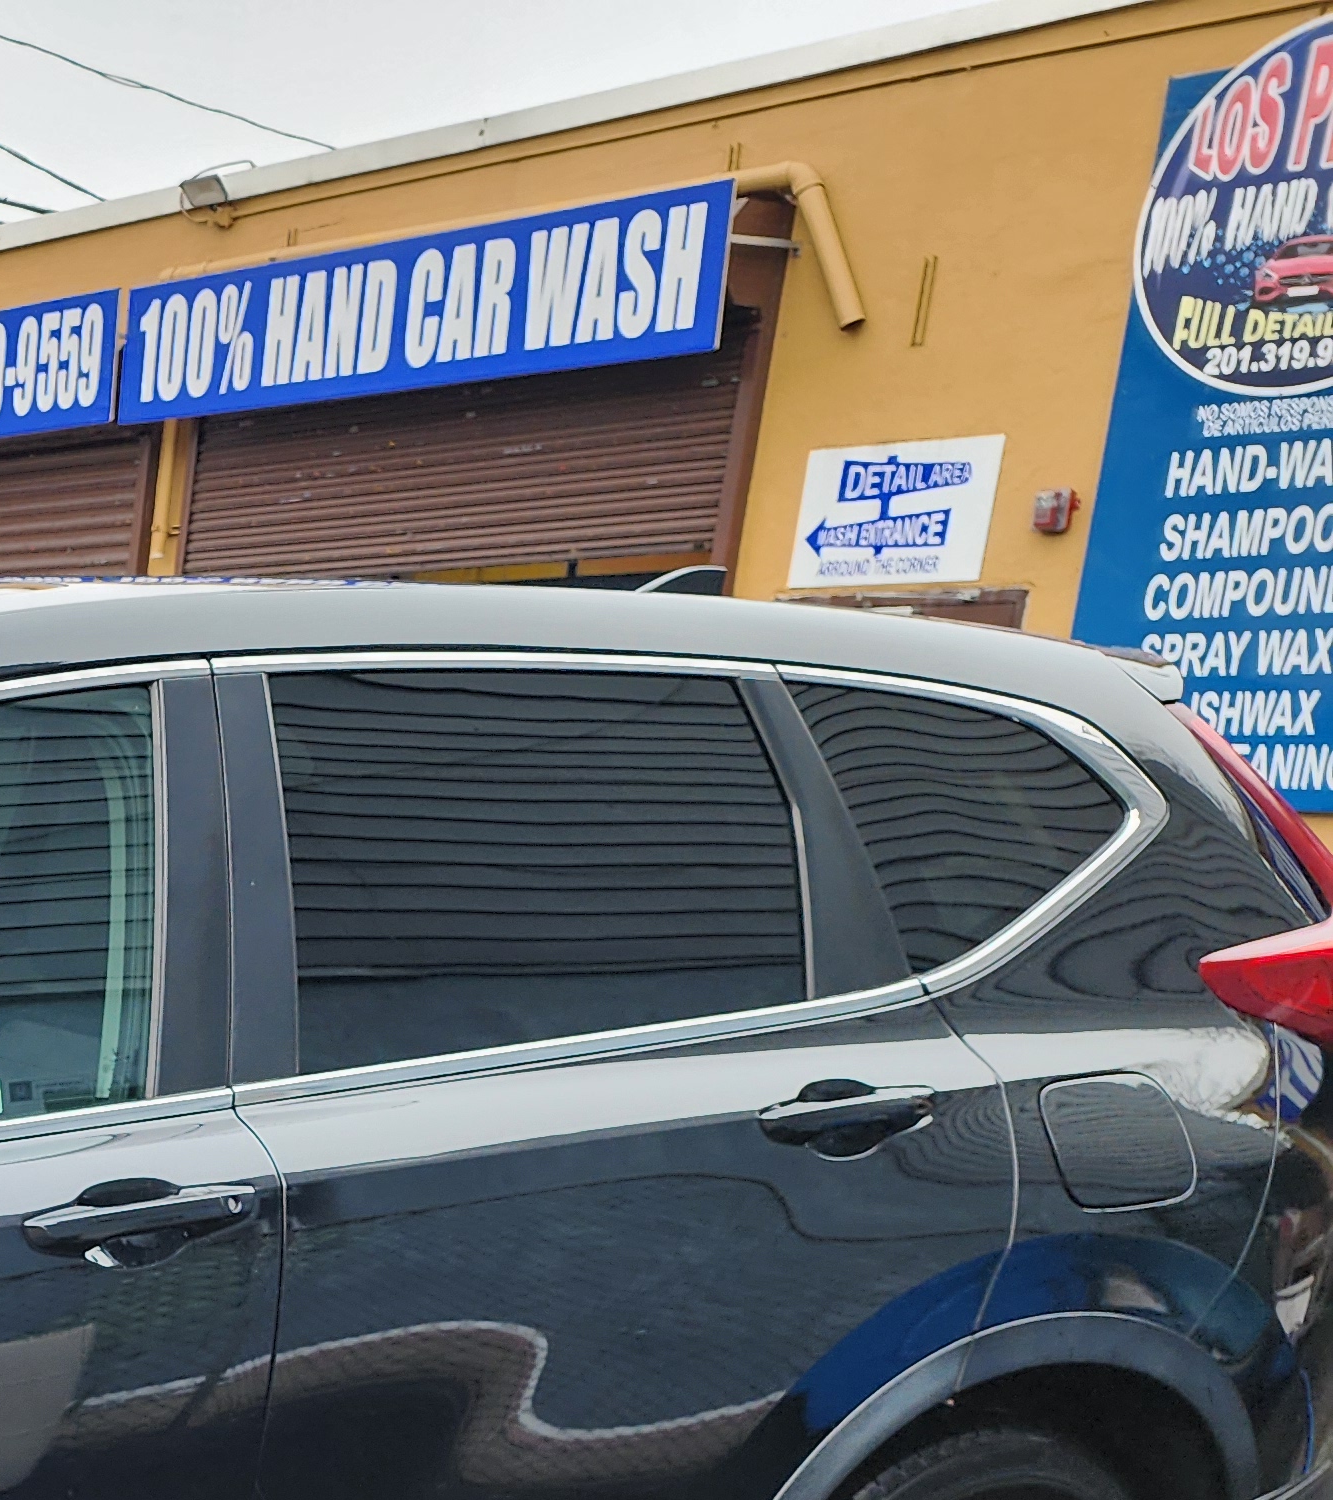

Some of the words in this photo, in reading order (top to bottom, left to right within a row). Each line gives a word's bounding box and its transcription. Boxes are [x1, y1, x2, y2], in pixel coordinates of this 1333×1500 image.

[1188, 52, 1293, 183] LOS
[1287, 35, 1333, 172] P
[1143, 187, 1218, 279] 100%
[1225, 177, 1319, 252] HAND
[139, 281, 252, 403] 100%
[261, 259, 398, 387] HAND
[405, 237, 517, 369] CAR
[524, 201, 709, 351] WASH
[1173, 296, 1236, 350] FULL
[1202, 419, 1224, 437] DE
[844, 464, 927, 499] DETAIL
[927, 462, 973, 487] AREA
[817, 523, 859, 547] WASH
[859, 512, 945, 546] ENTRANCE
[876, 557, 894, 575] THE
[896, 554, 940, 574] CORNER
[1257, 627, 1333, 675] WAX
